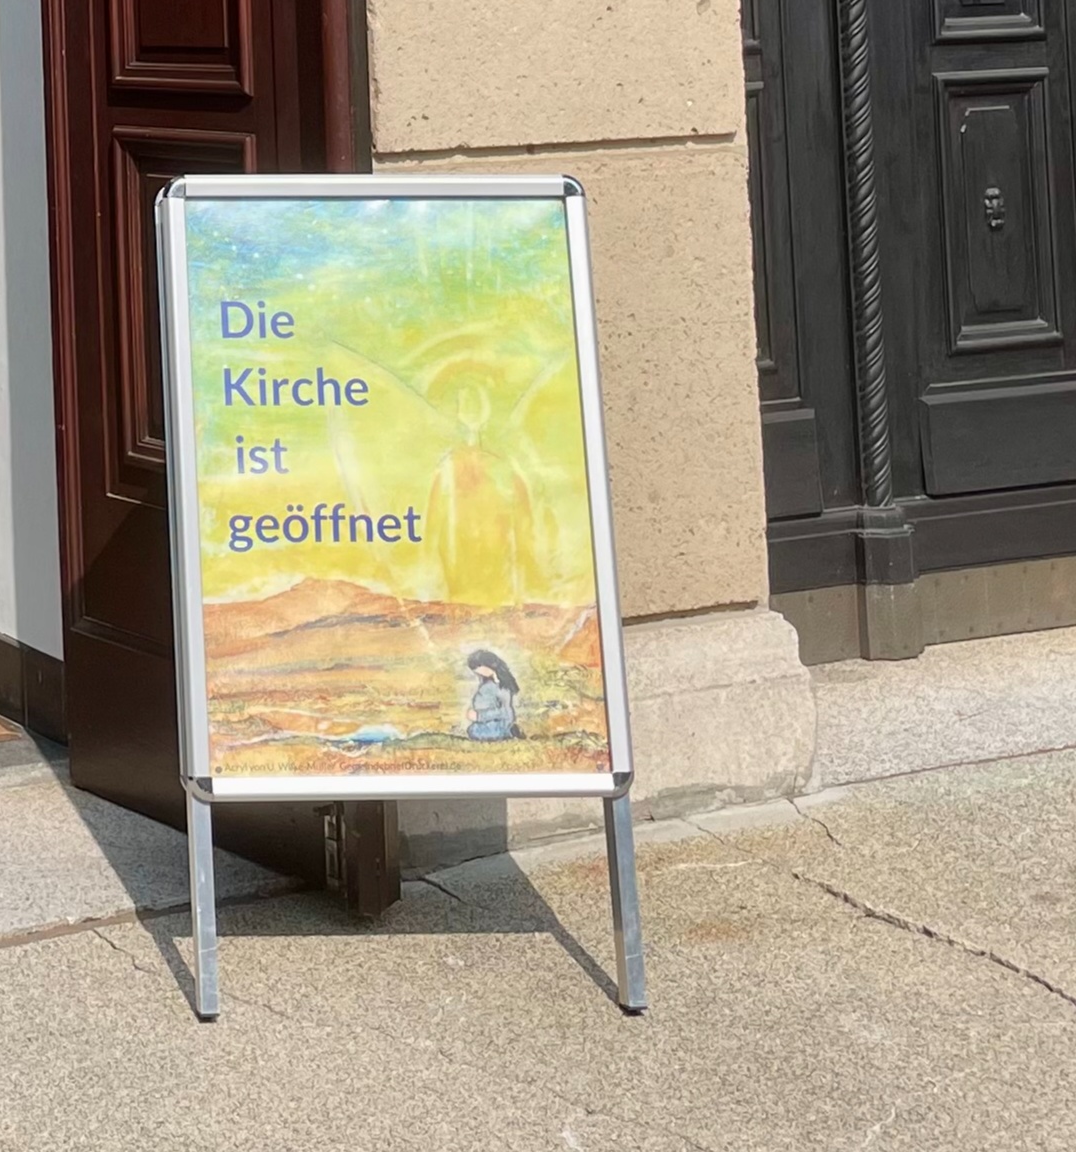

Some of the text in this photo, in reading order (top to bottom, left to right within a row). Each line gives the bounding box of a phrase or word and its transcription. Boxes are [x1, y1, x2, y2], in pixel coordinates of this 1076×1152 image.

[220, 300, 295, 339] Die
[223, 367, 369, 407] Kirche
[235, 435, 289, 475] ist
[228, 503, 422, 552] geöffnet
